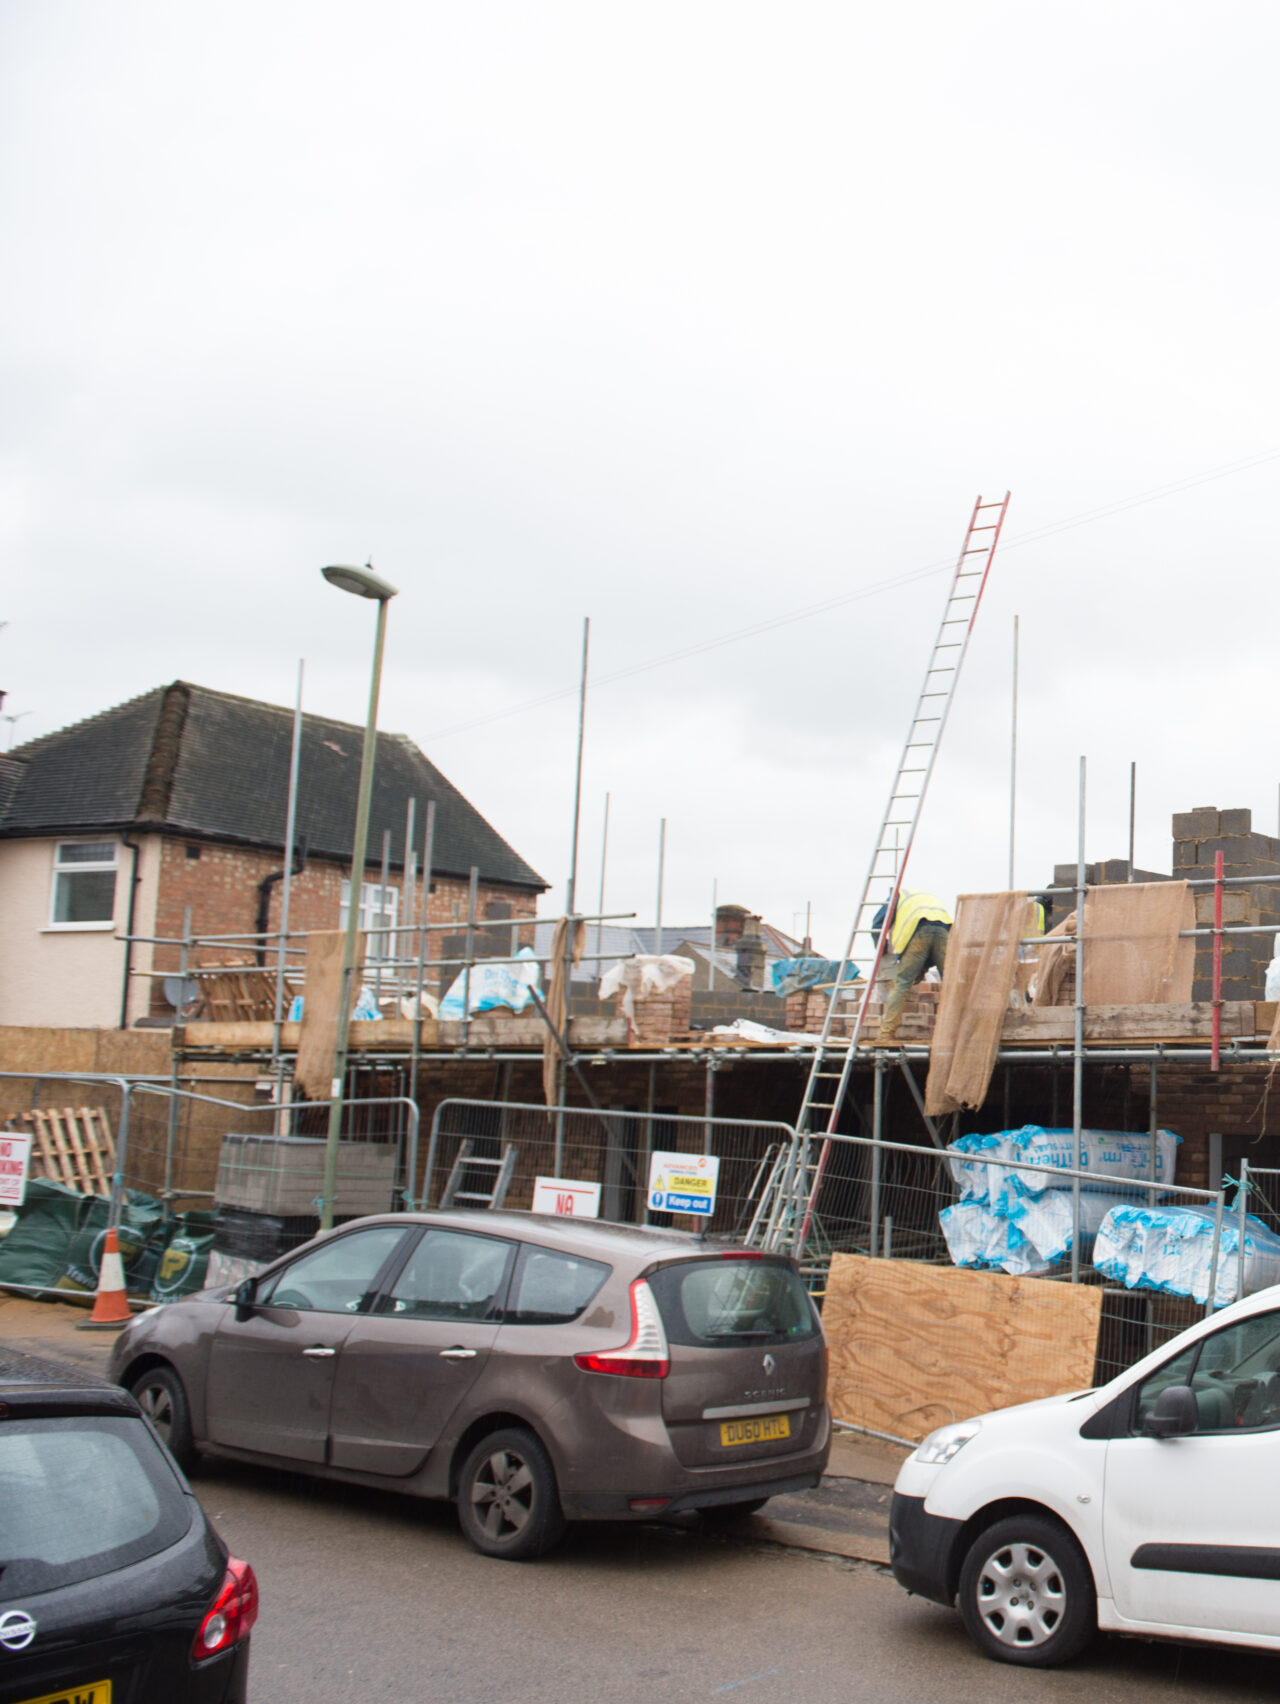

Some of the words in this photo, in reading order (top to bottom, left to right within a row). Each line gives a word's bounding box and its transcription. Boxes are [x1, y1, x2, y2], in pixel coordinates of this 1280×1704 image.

[0, 1160, 24, 1176] KING
[674, 1177, 707, 1187] DANGER
[669, 1195, 691, 1210] Keep
[692, 1199, 708, 1209] out
[727, 1421, 761, 1442] DU60
